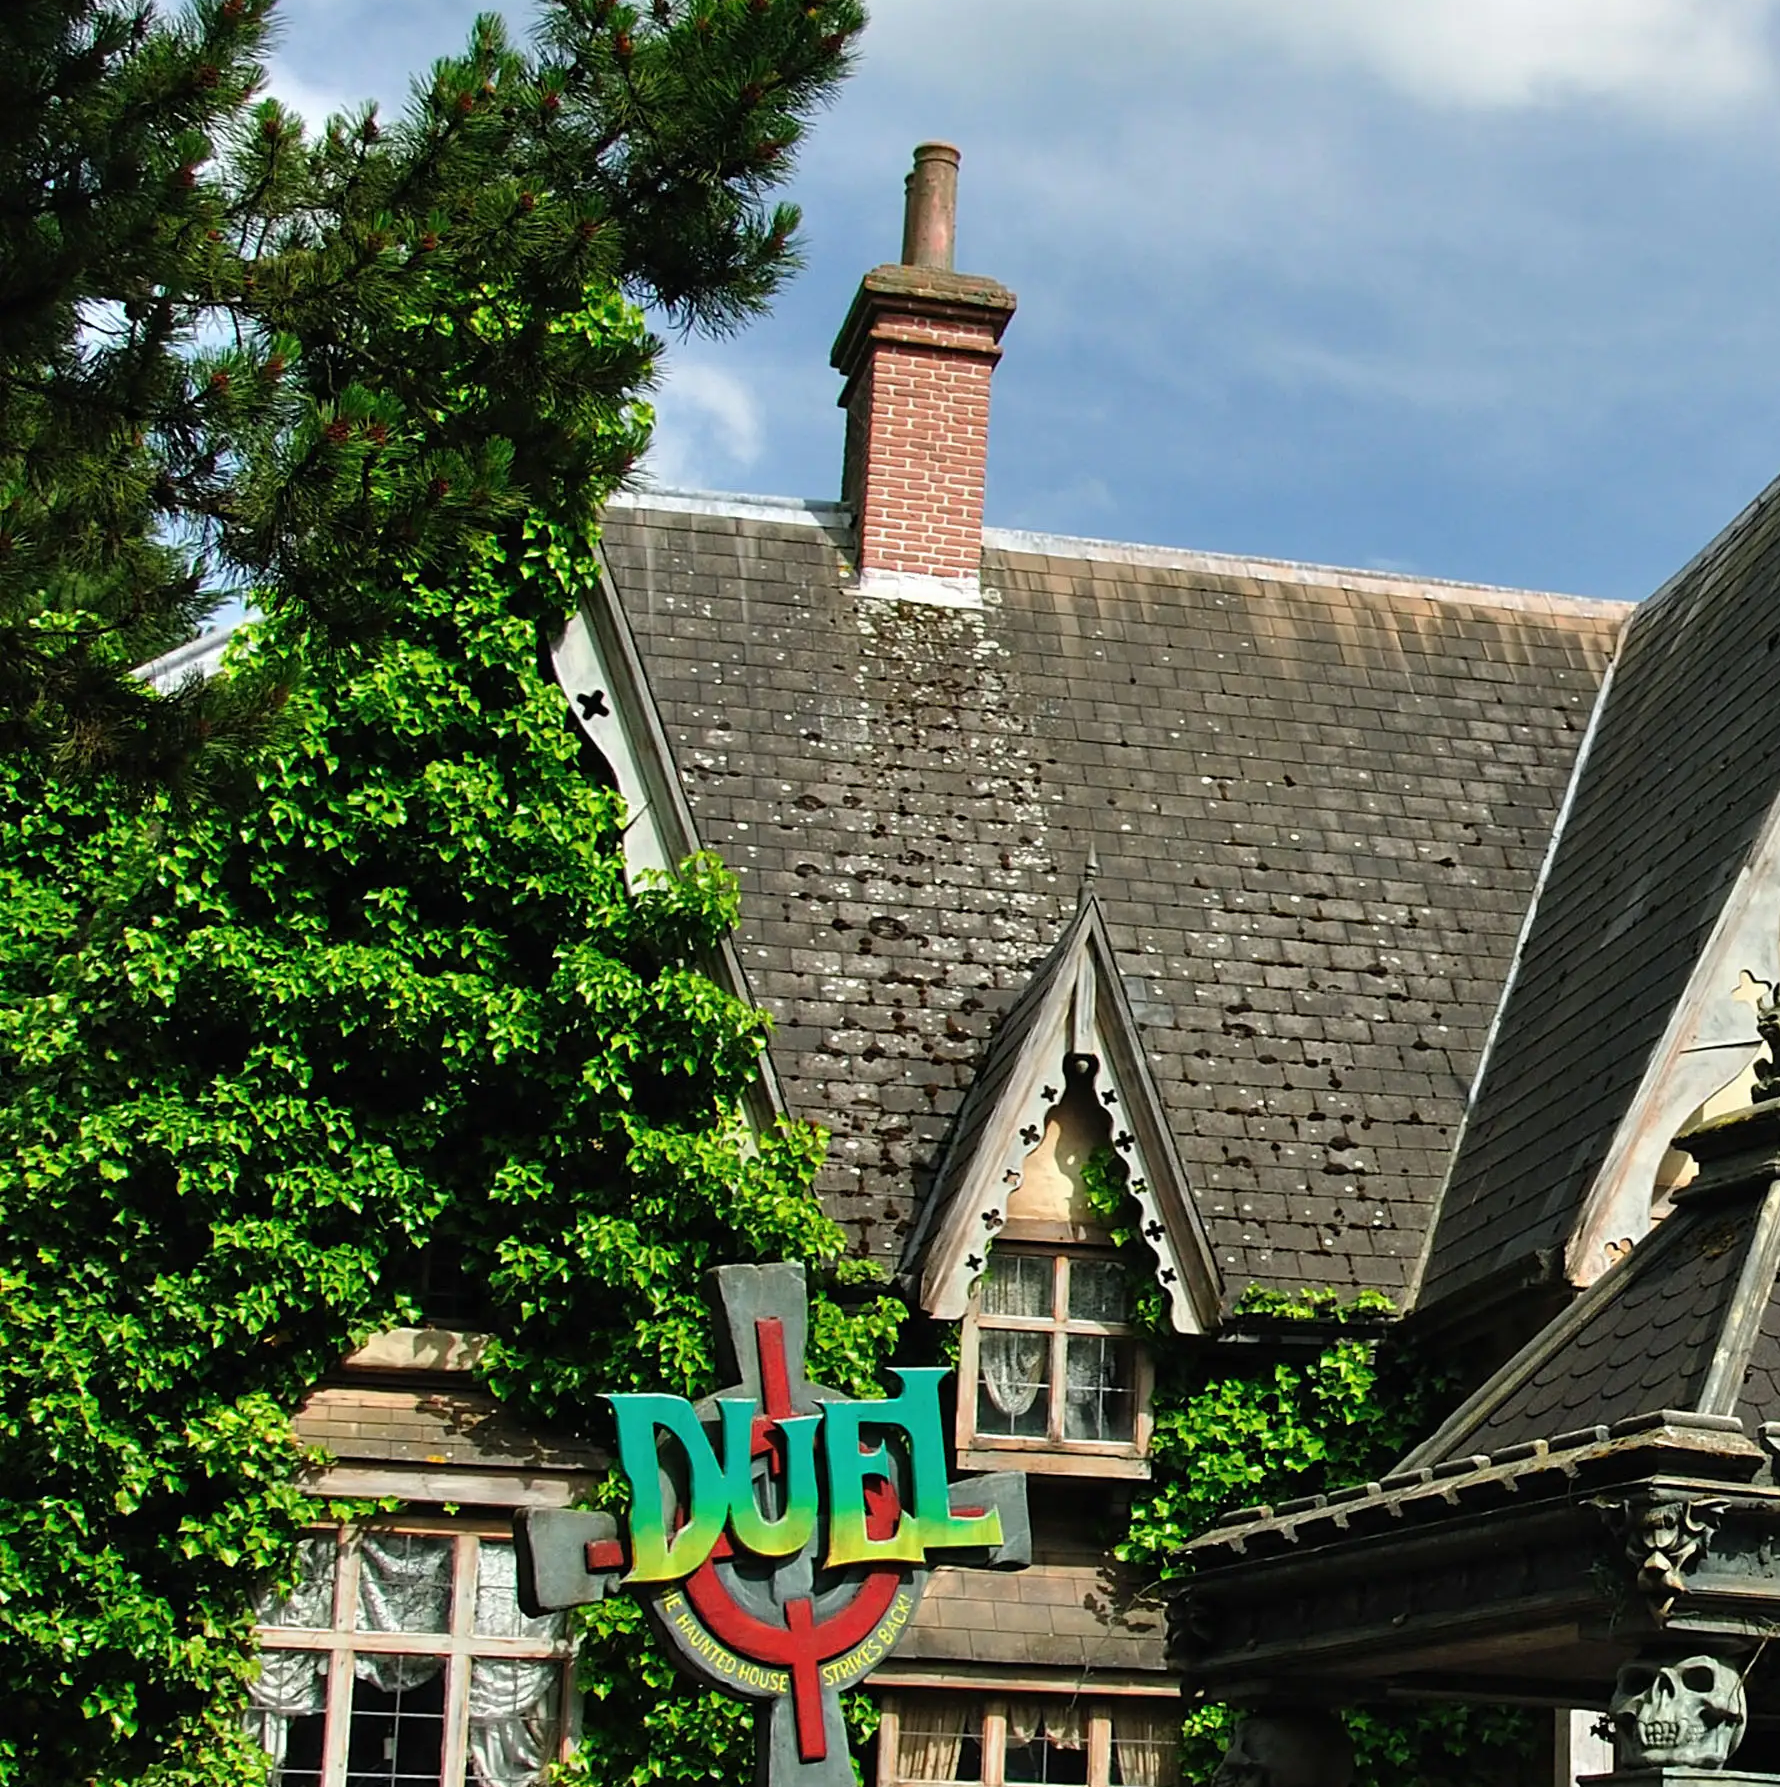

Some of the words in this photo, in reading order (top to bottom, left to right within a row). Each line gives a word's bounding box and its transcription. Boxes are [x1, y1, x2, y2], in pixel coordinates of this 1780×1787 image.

[596, 1367, 1003, 1583] DUEL
[676, 1613, 736, 1674] HAUNTED
[738, 1664, 789, 1692] HOUSE
[822, 1639, 883, 1686] STRIKES
[878, 1593, 914, 1645] BACK!
